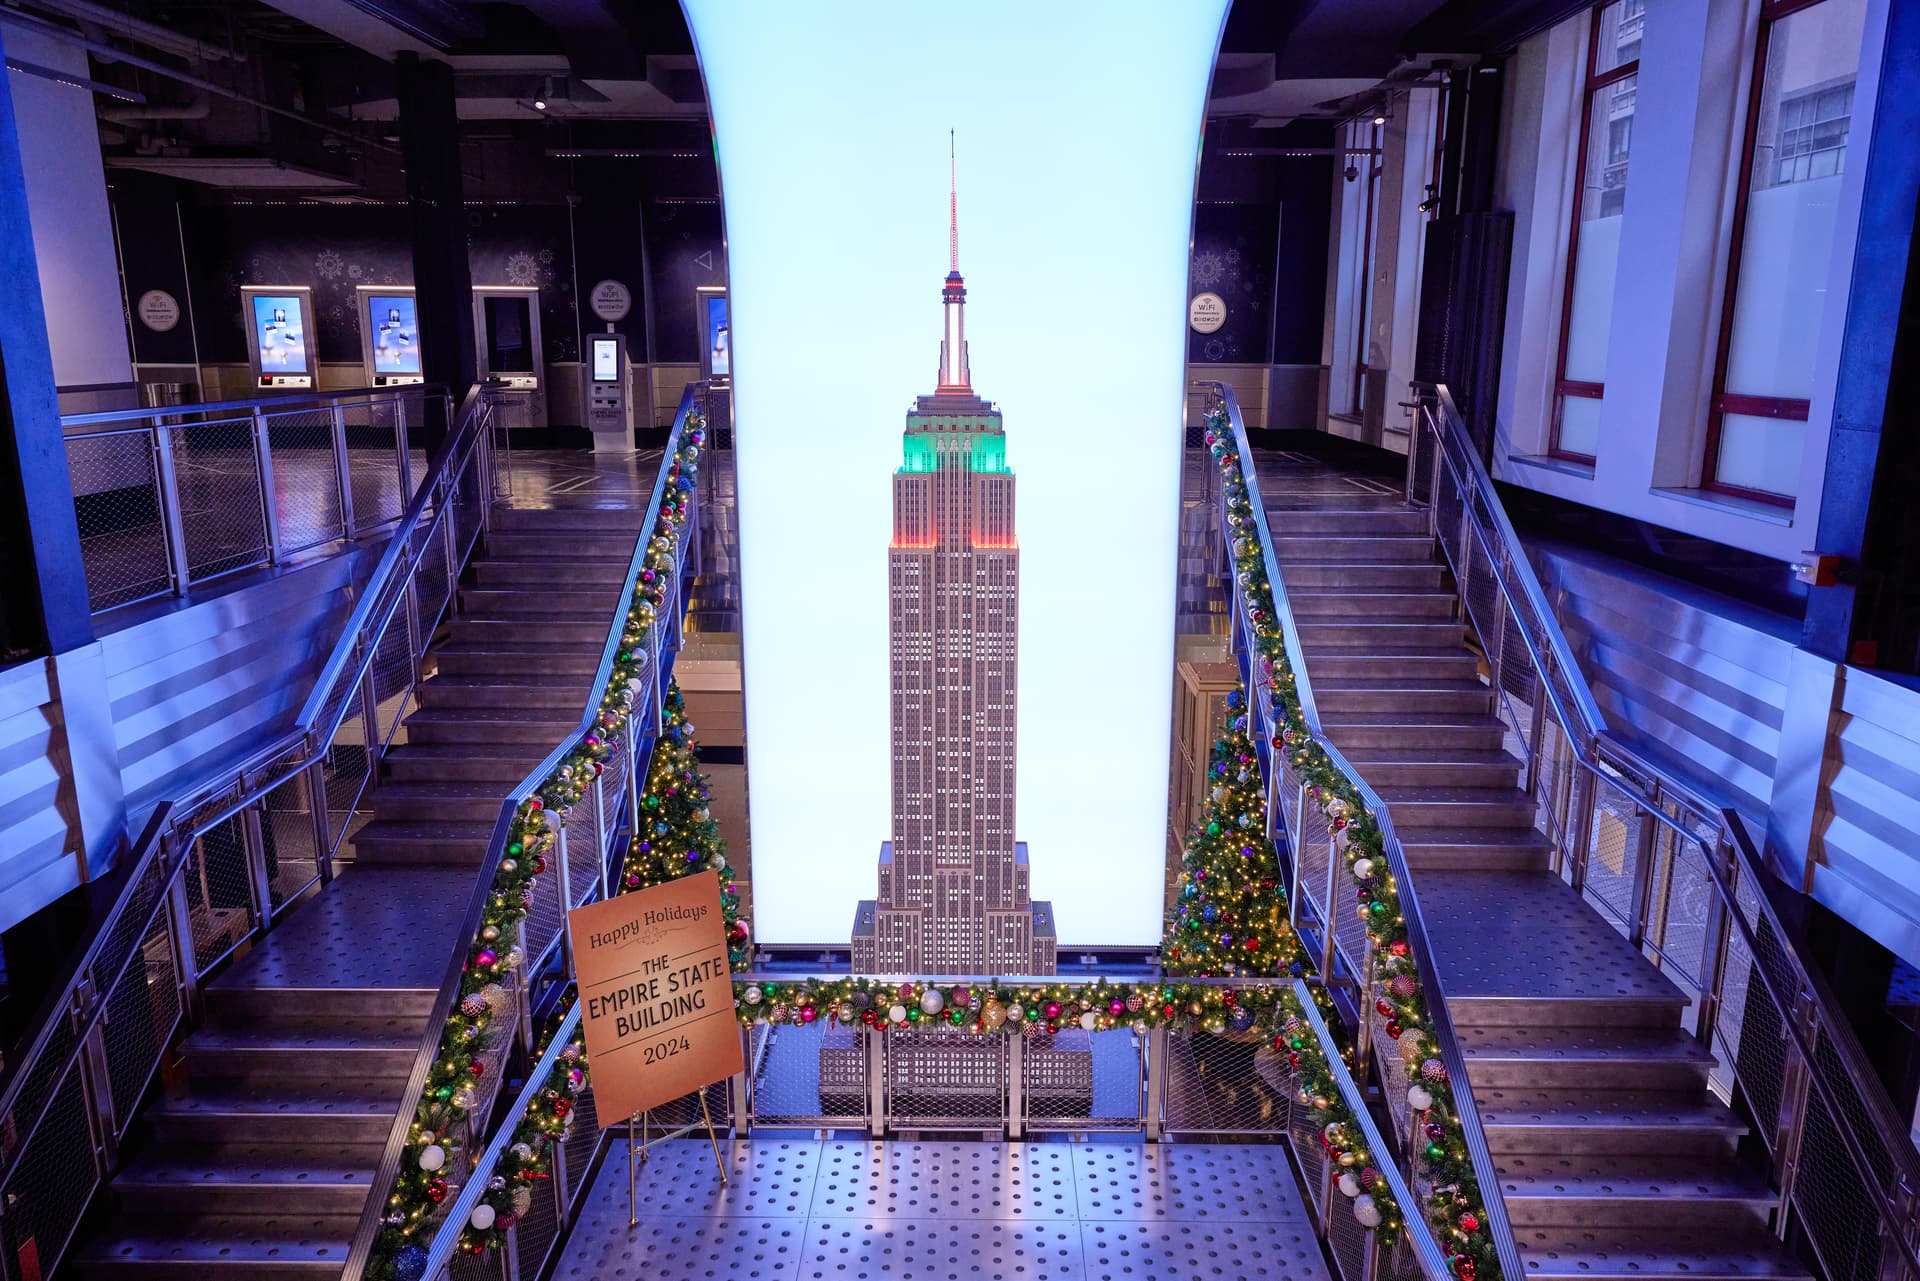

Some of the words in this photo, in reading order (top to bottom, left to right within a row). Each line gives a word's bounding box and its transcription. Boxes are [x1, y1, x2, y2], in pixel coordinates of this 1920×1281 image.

[590, 920, 640, 949] Happy
[644, 905, 708, 926] Holidays
[641, 954, 670, 975] THE
[588, 978, 661, 1020] EMPIRE
[668, 957, 724, 992] STATE
[616, 989, 705, 1038] BUILDING
[643, 1035, 690, 1065] 2024
